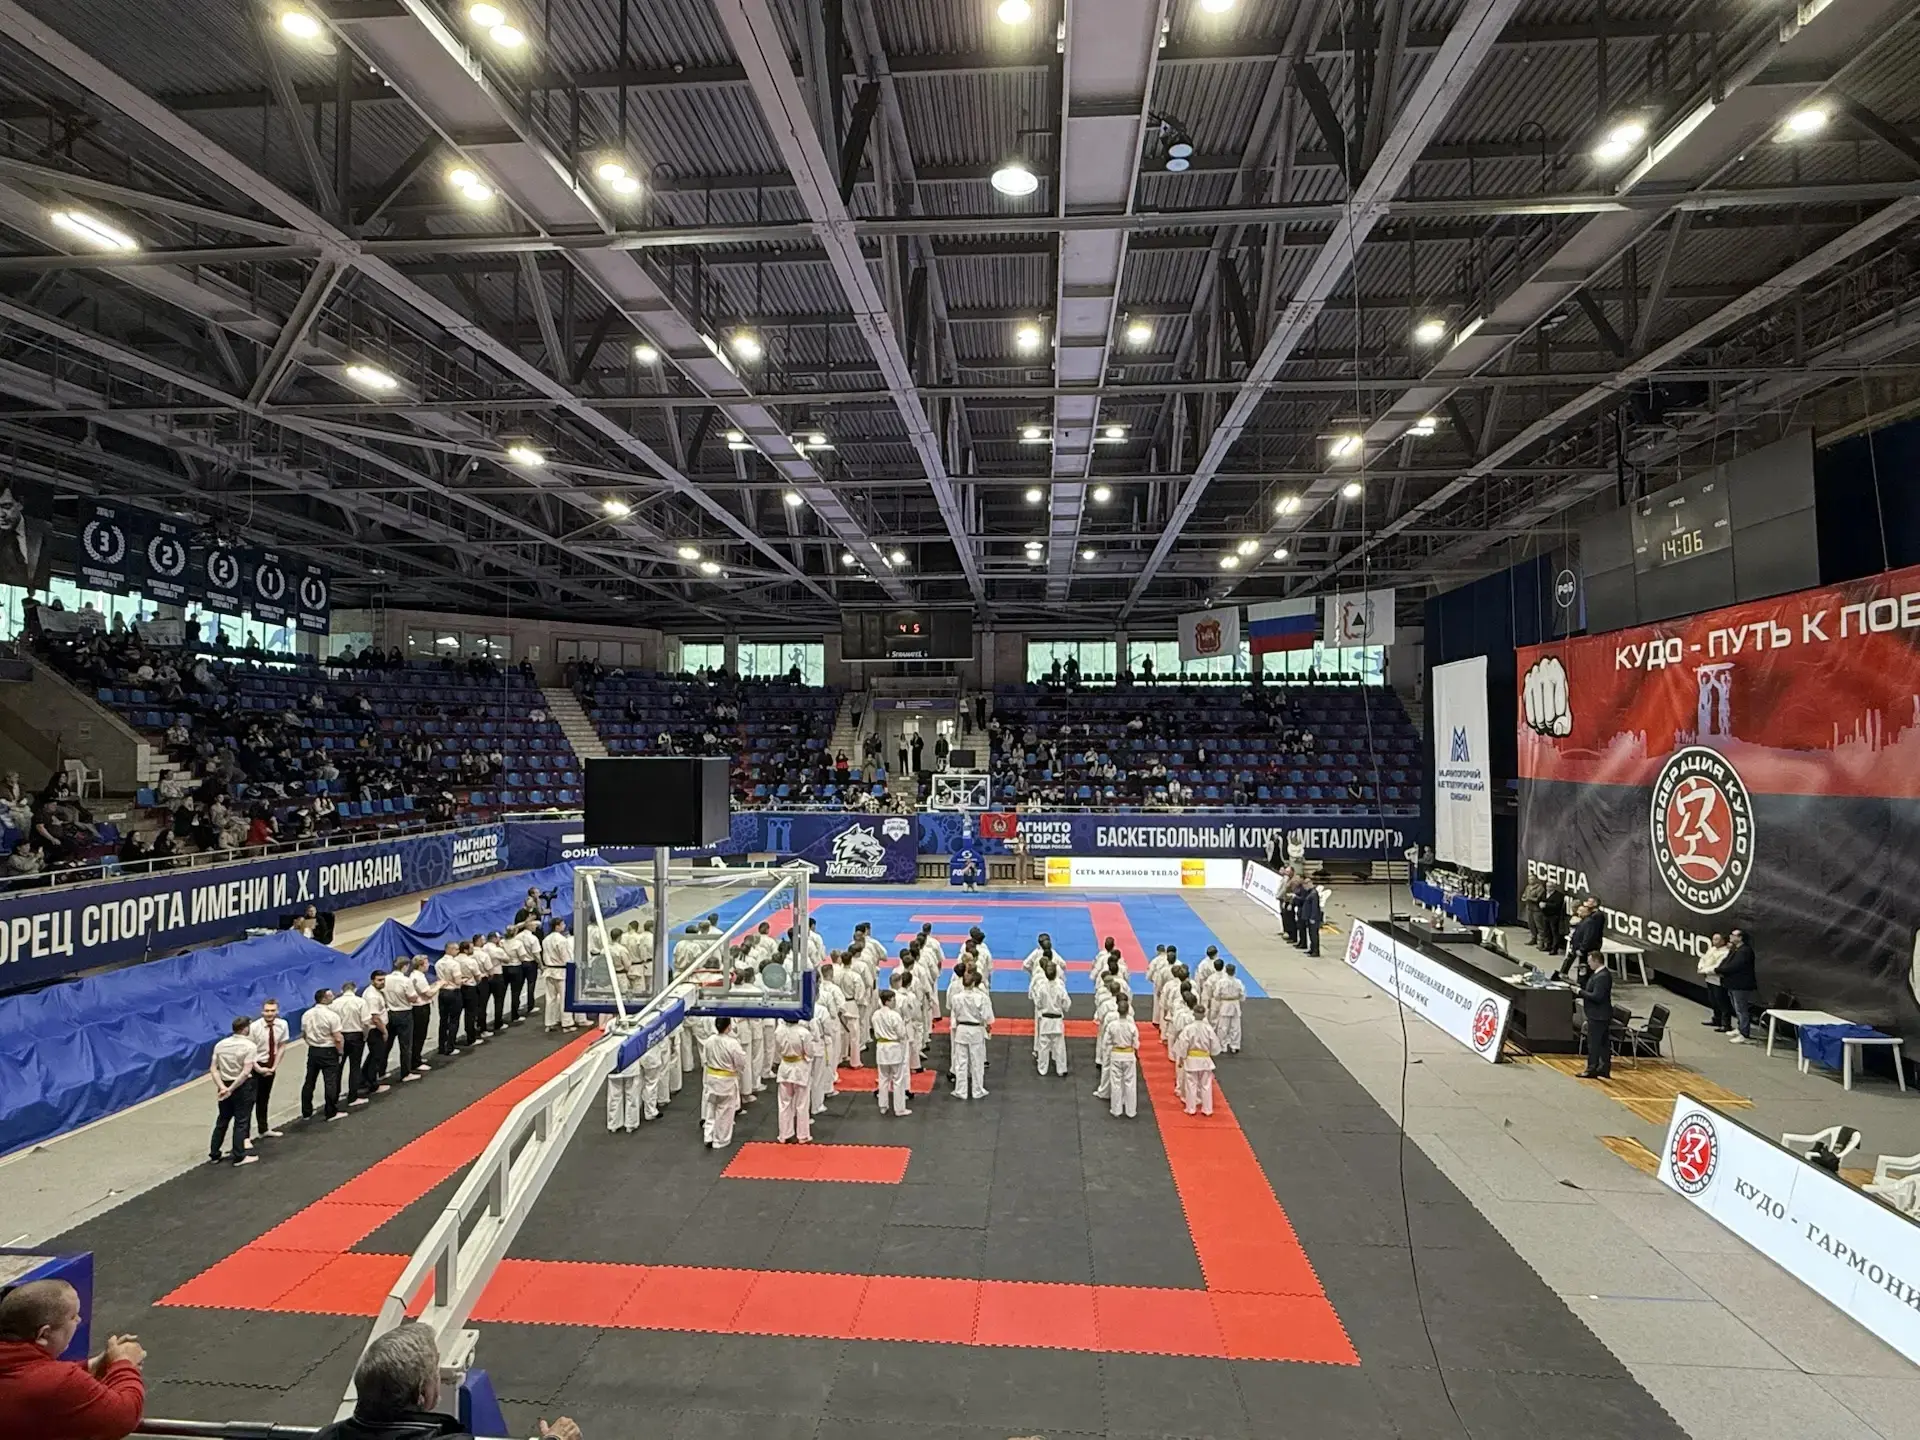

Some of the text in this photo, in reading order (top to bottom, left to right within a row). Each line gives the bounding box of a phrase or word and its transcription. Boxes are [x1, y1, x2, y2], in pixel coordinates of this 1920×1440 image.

[100, 531, 109, 552] 3
[1662, 530, 1703, 561] 14:06
[162, 546, 172, 565] 2
[219, 560, 228, 579] 2
[268, 573, 273, 590] 1
[311, 584, 316, 600] 1
[1615, 638, 1683, 671] КУДО
[1708, 620, 1791, 658] ПУТЬ
[1803, 610, 1829, 643] К
[1656, 756, 1747, 855] ФЕДЕРАЦИЯ КУДО
[1016, 821, 1072, 833] АГНИТО
[1096, 823, 1235, 848] БАСКЕТБОЛЬНЫЙ
[453, 834, 498, 854] МАГНИТО
[561, 848, 599, 859] ФОНД
[1076, 868, 1095, 876] СЕТЬ
[1099, 868, 1149, 876] МАГАЗИНОВ
[1151, 868, 1179, 877] ТЕПЛО
[1667, 865, 1735, 905] РОССИИ
[82, 890, 185, 947] СПОРТА
[191, 875, 269, 925] ИМЕНИ
[273, 873, 292, 908] И.
[296, 870, 315, 903] Х.
[318, 853, 402, 898] РОМАЗАНА
[1733, 1176, 1786, 1221] КУДО
